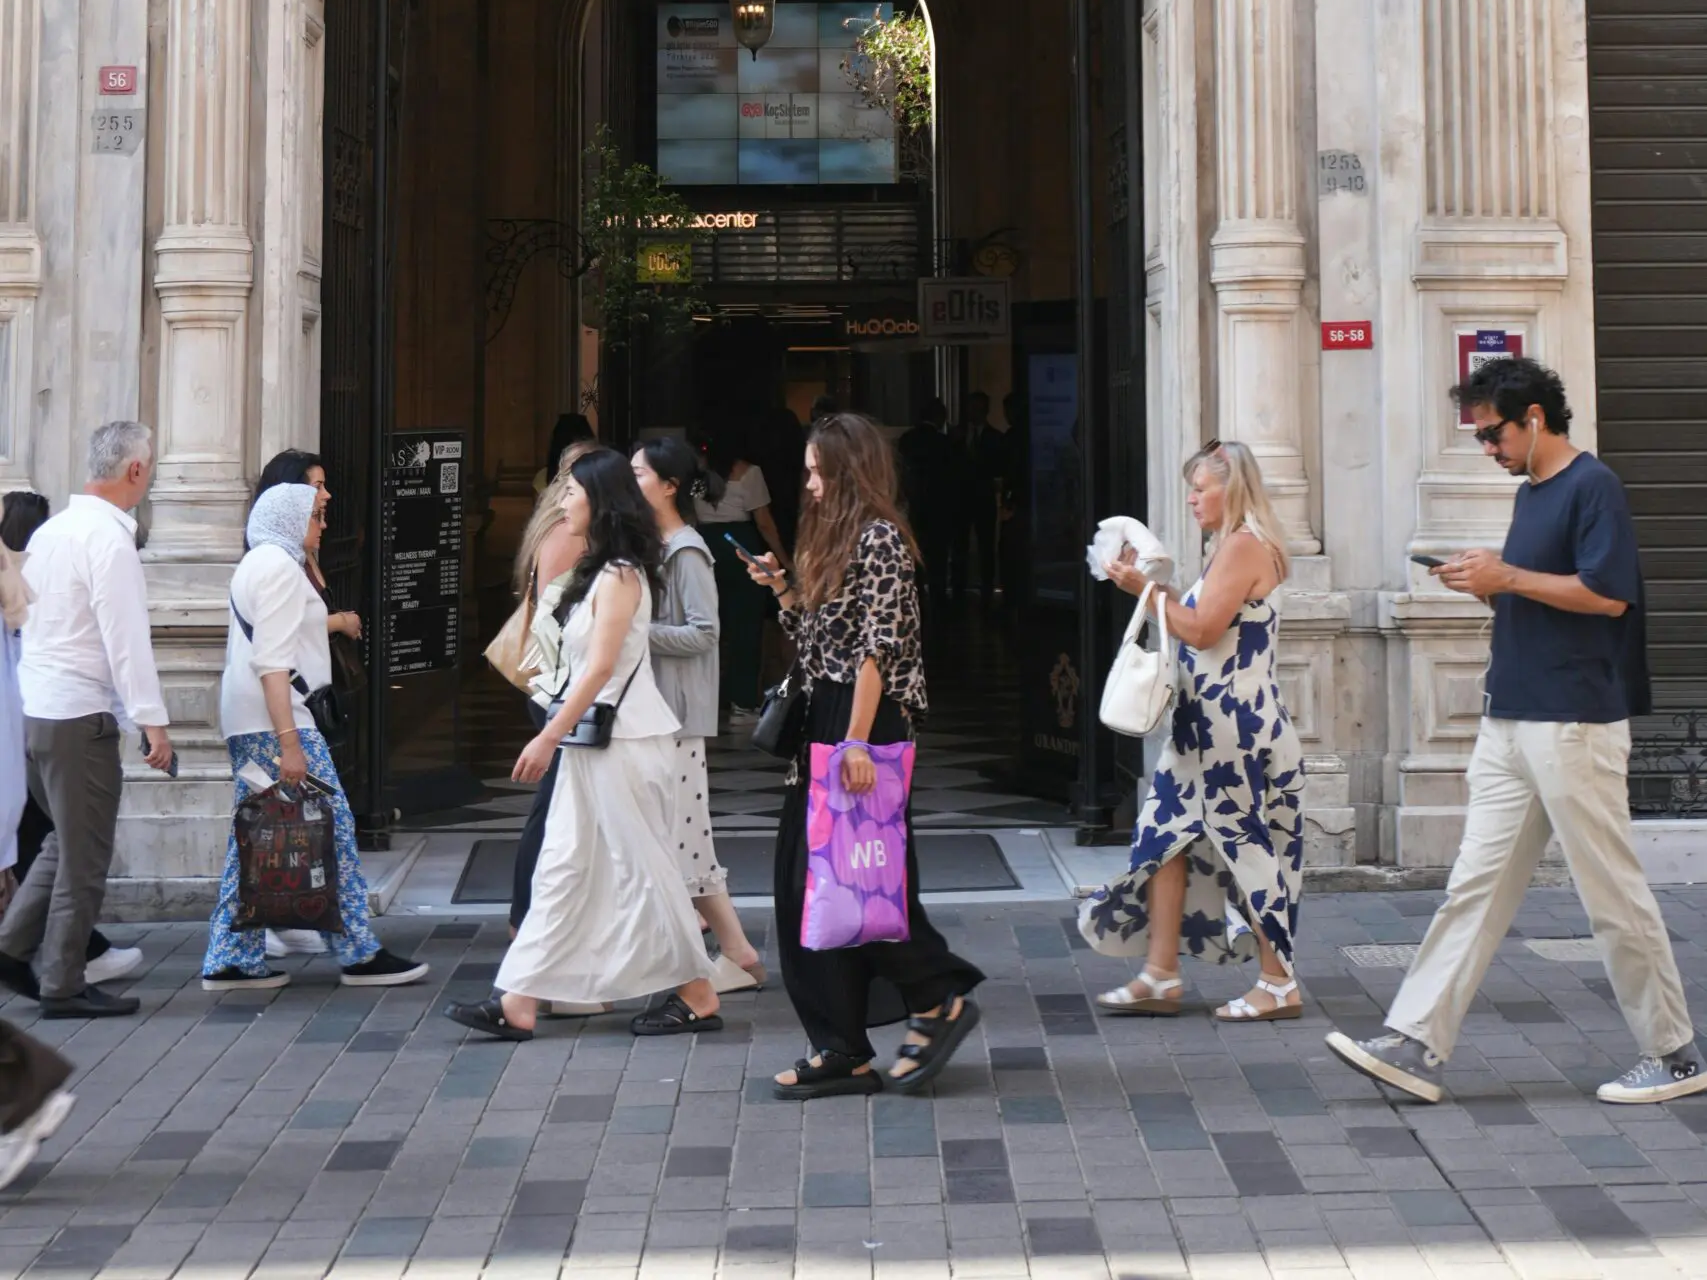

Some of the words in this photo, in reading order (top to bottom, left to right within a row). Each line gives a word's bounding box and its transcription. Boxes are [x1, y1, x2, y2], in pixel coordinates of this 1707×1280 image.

[108, 72, 127, 88] 56
[846, 318, 919, 335] HuQQab
[1330, 329, 1364, 342] 56-58
[435, 445, 445, 455] VIP
[396, 488, 417, 497] WOMAN
[420, 487, 431, 496] MAN
[394, 550, 418, 561] WELLNESS
[418, 549, 437, 559] THERAPY
[401, 600, 420, 609] BEAUTY
[851, 839, 887, 869] WB
